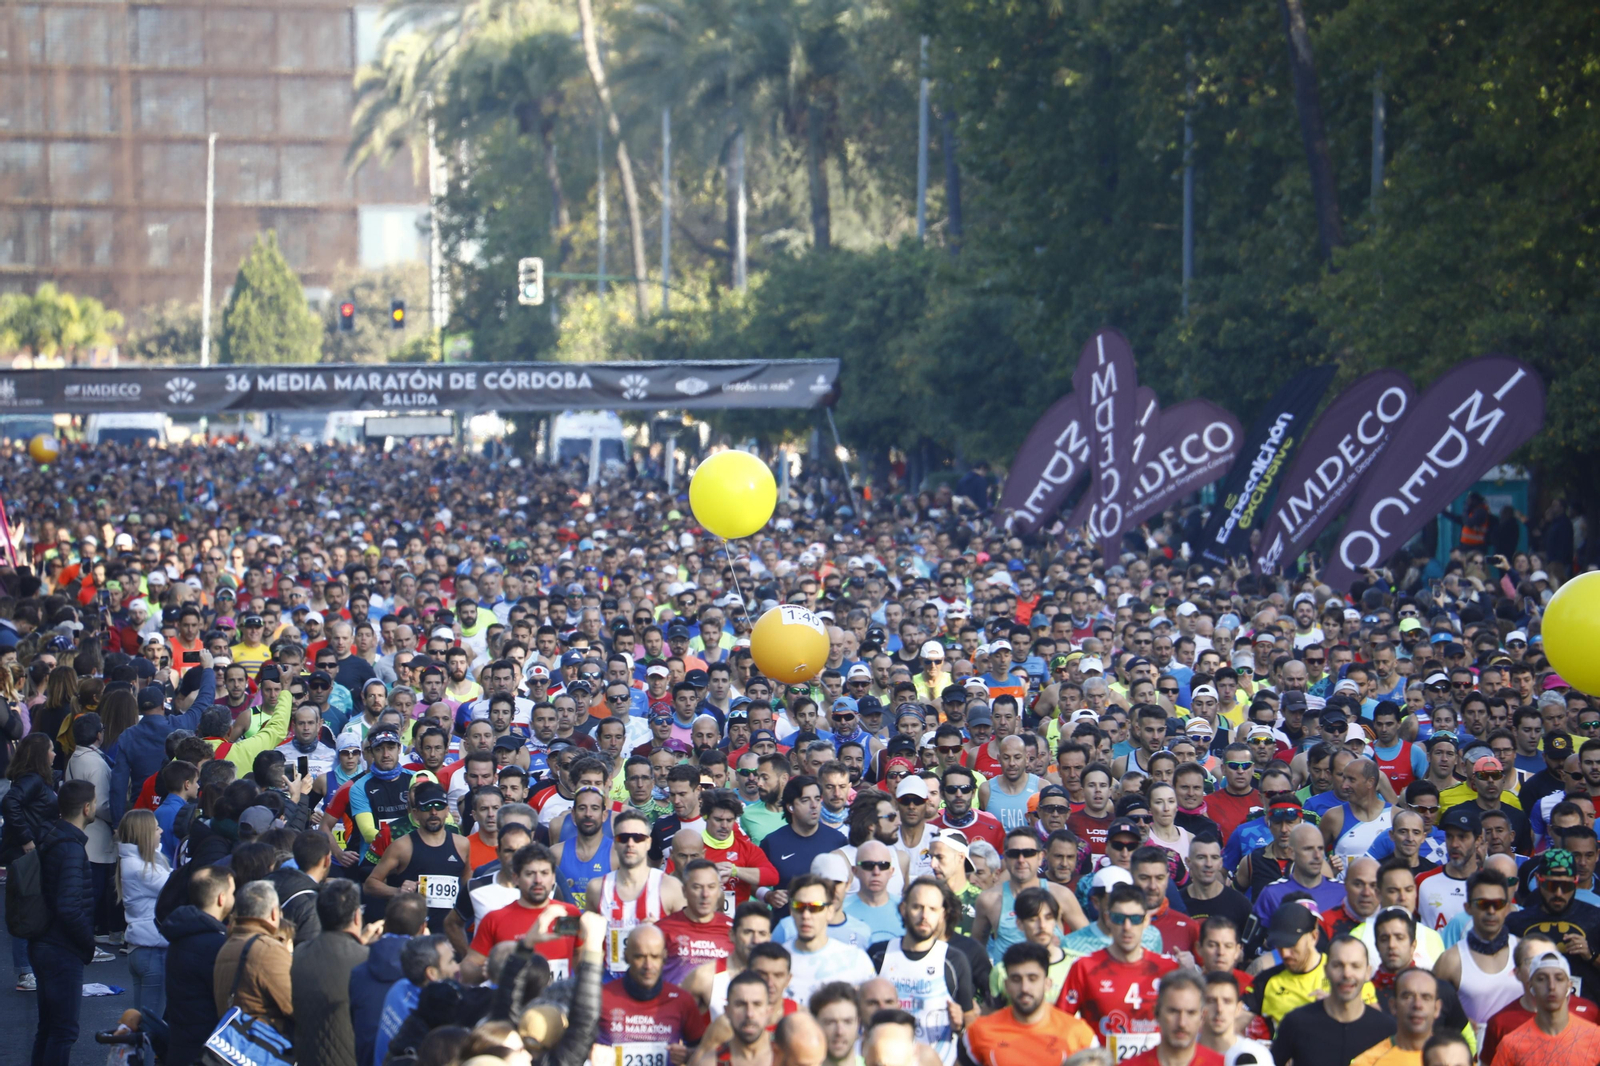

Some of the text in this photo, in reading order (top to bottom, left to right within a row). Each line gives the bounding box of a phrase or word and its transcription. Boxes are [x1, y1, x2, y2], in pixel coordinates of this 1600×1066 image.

[225, 368, 593, 392] 36 MEDIA MARATÓN DE CÓRDOBA
[82, 383, 142, 397] IMDECO
[382, 393, 438, 406] SALIDA
[1132, 421, 1234, 500] DECO
[1277, 387, 1406, 535] IMDECO
[1340, 367, 1527, 571] IMDECO
[1238, 437, 1293, 529] exclusive
[1346, 472, 1357, 484] de
[787, 609, 820, 626] 1:40
[428, 883, 457, 897] 1998
[678, 940, 716, 956] 36 MEDIA
[691, 948, 729, 959] MARATÓN
[1124, 982, 1142, 1010] 4
[610, 1014, 655, 1032] 36 MEDIA
[625, 1023, 673, 1034] MARATÓN
[624, 1053, 665, 1066] 2338
